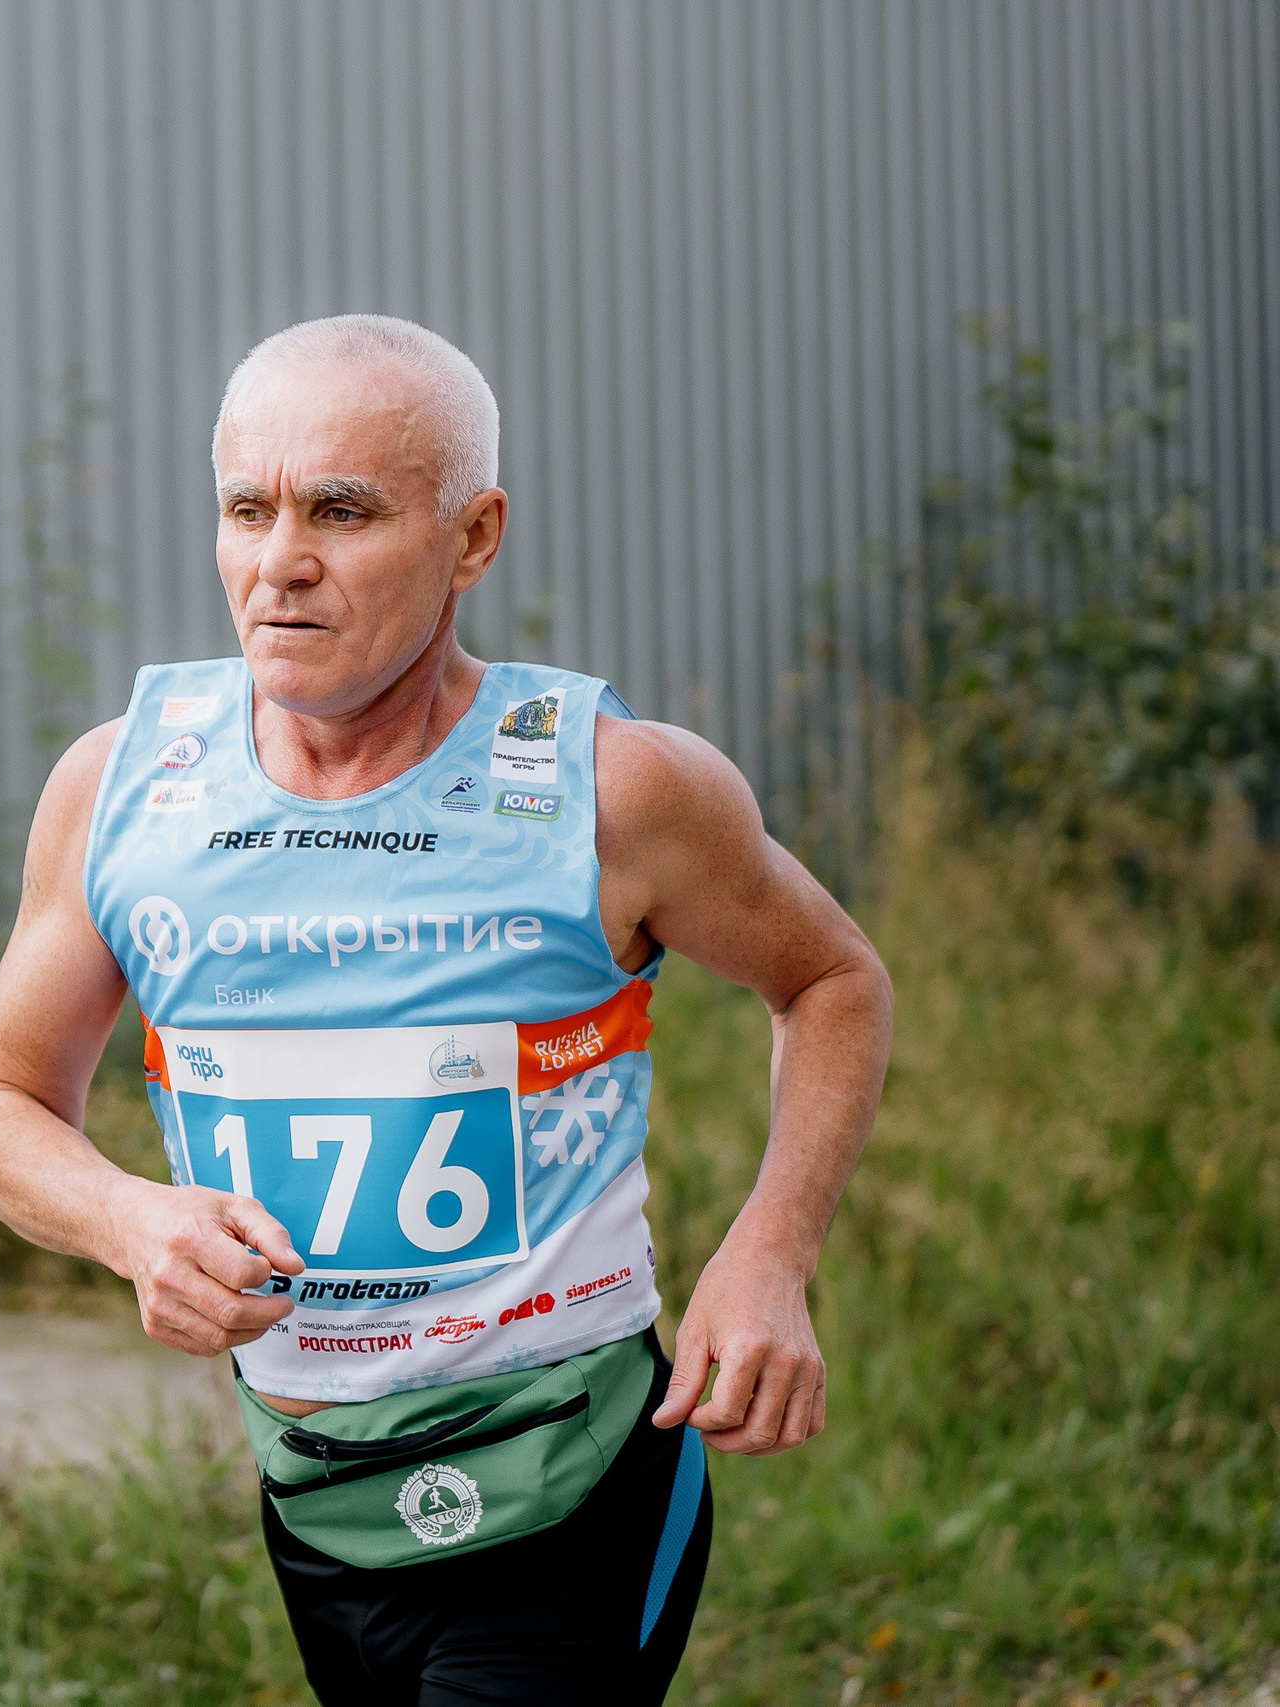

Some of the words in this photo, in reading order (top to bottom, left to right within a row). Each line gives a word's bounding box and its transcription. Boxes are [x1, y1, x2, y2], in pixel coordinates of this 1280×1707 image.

[492, 752, 556, 764] ПРАВИТЕЛЬСТВО
[511, 763, 535, 771] ЮГРЫ
[503, 793, 556, 814] ЮМС
[208, 831, 277, 849] FREE
[283, 829, 438, 854] TECHNIQUE
[207, 913, 543, 967] открытие
[214, 984, 275, 1005] Банк
[534, 1021, 600, 1057] RUSSIA
[540, 1035, 604, 1072] LOPPET
[213, 1108, 490, 1253] 176
[565, 1265, 632, 1300] siapress.ru
[297, 1320, 355, 1332] ОФИЦИАЛЬНЫЙ
[355, 1319, 412, 1332] СТРАХОВЩИК
[298, 1332, 413, 1354] РОСГОССТРАХ
[434, 1510, 457, 1523] ГТО
